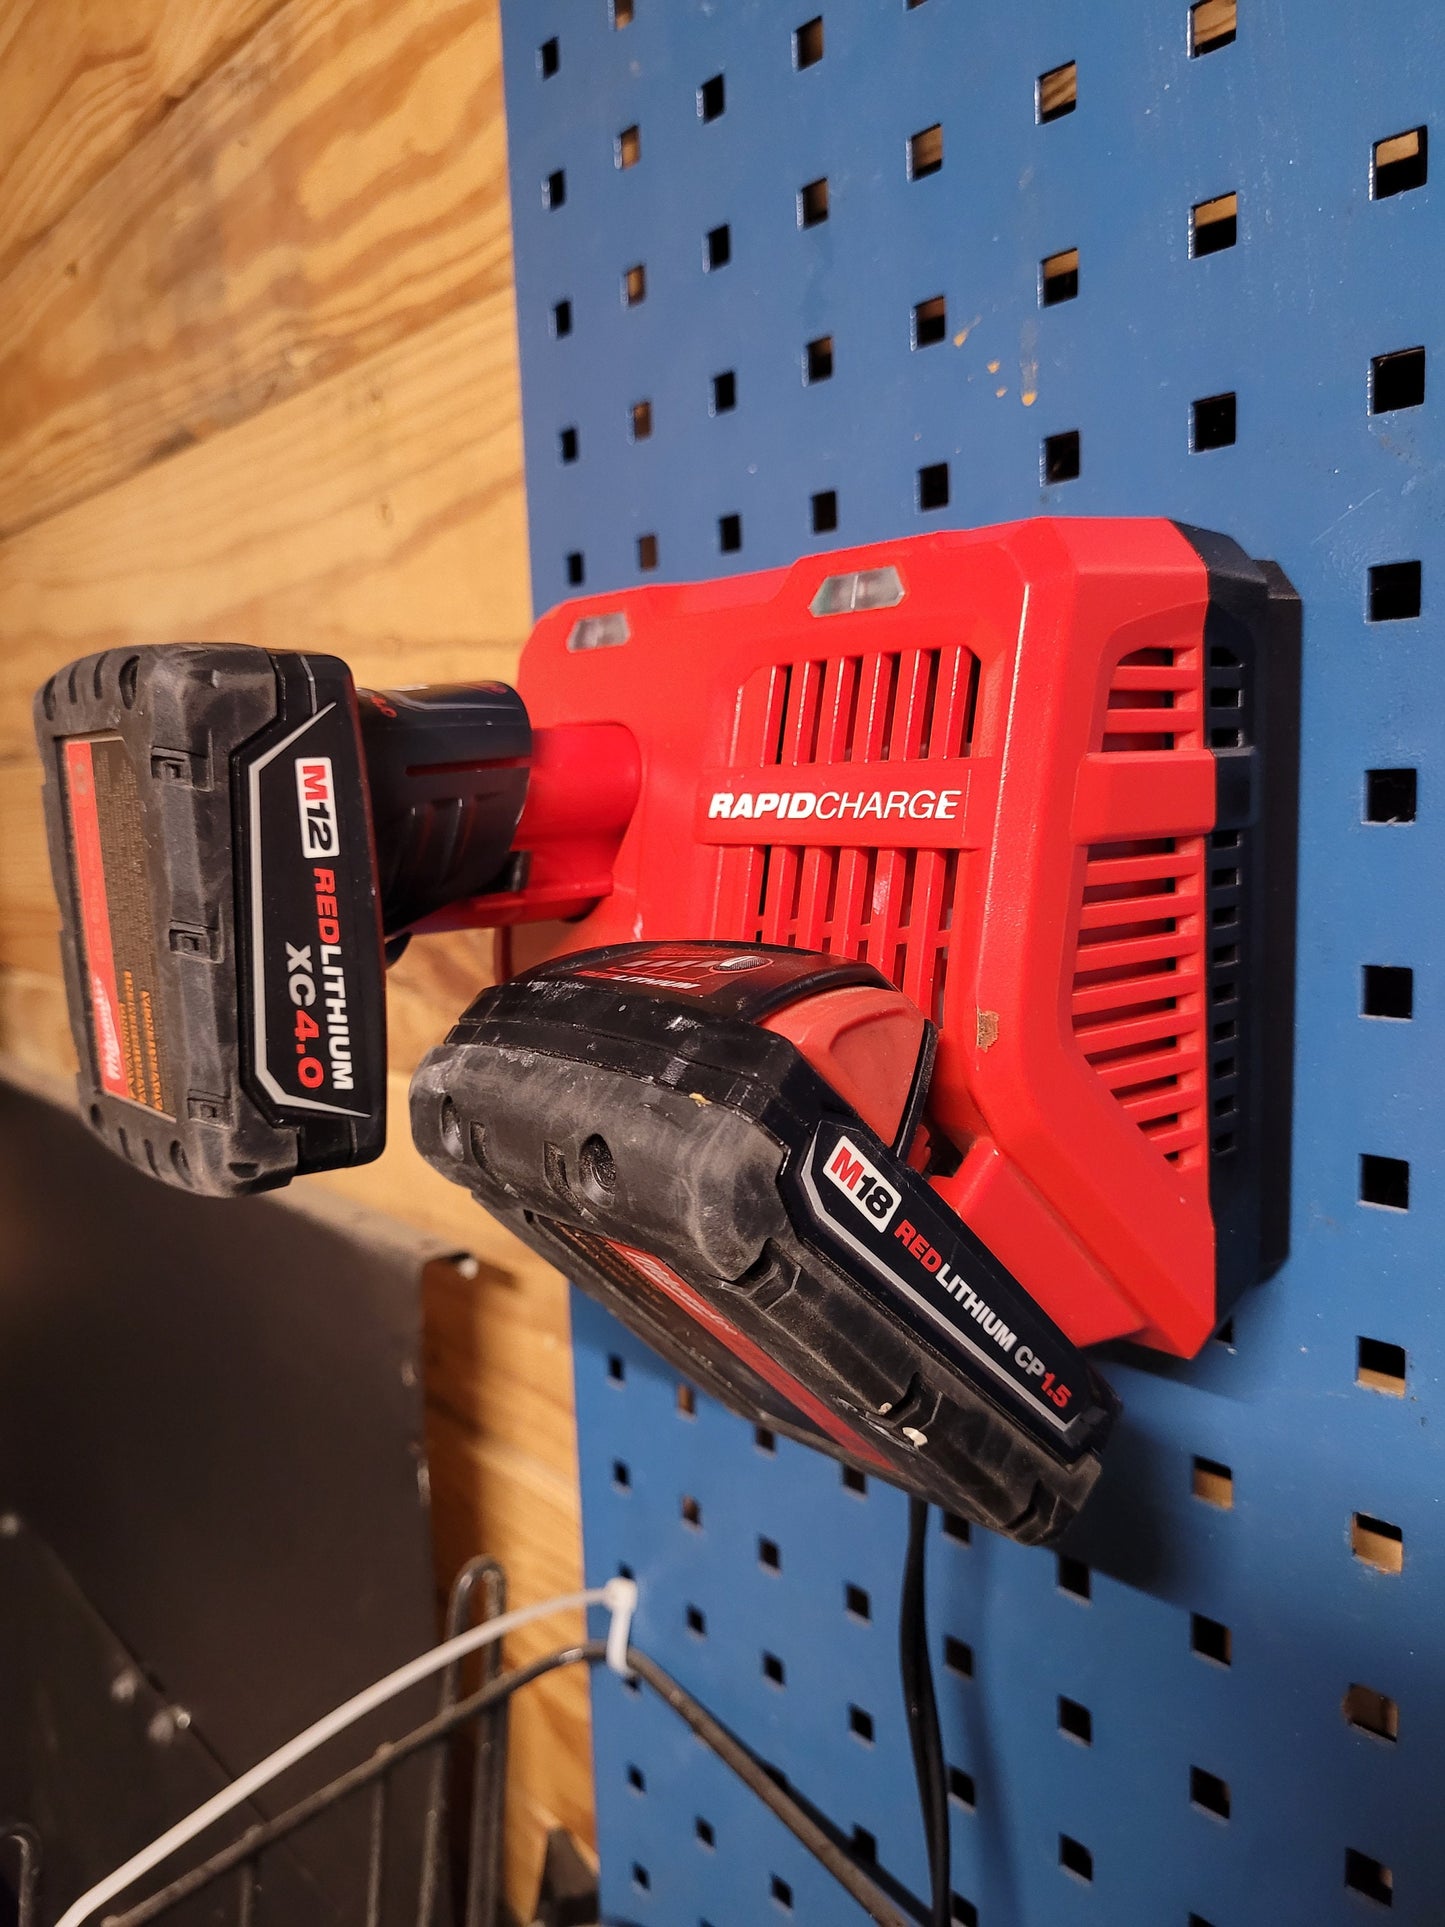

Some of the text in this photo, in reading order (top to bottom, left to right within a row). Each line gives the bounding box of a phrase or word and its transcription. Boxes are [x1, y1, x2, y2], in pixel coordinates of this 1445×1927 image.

[708, 790, 961, 820] RAPIDCHARGE
[303, 765, 354, 1090] M12 REDLITHIUM
[574, 970, 702, 990] REDLITHIUM
[92, 975, 121, 1081] Milwaukee
[285, 942, 324, 1089] XC4.0
[830, 1146, 1074, 1408] M18 REDLITHIUM CP1.5
